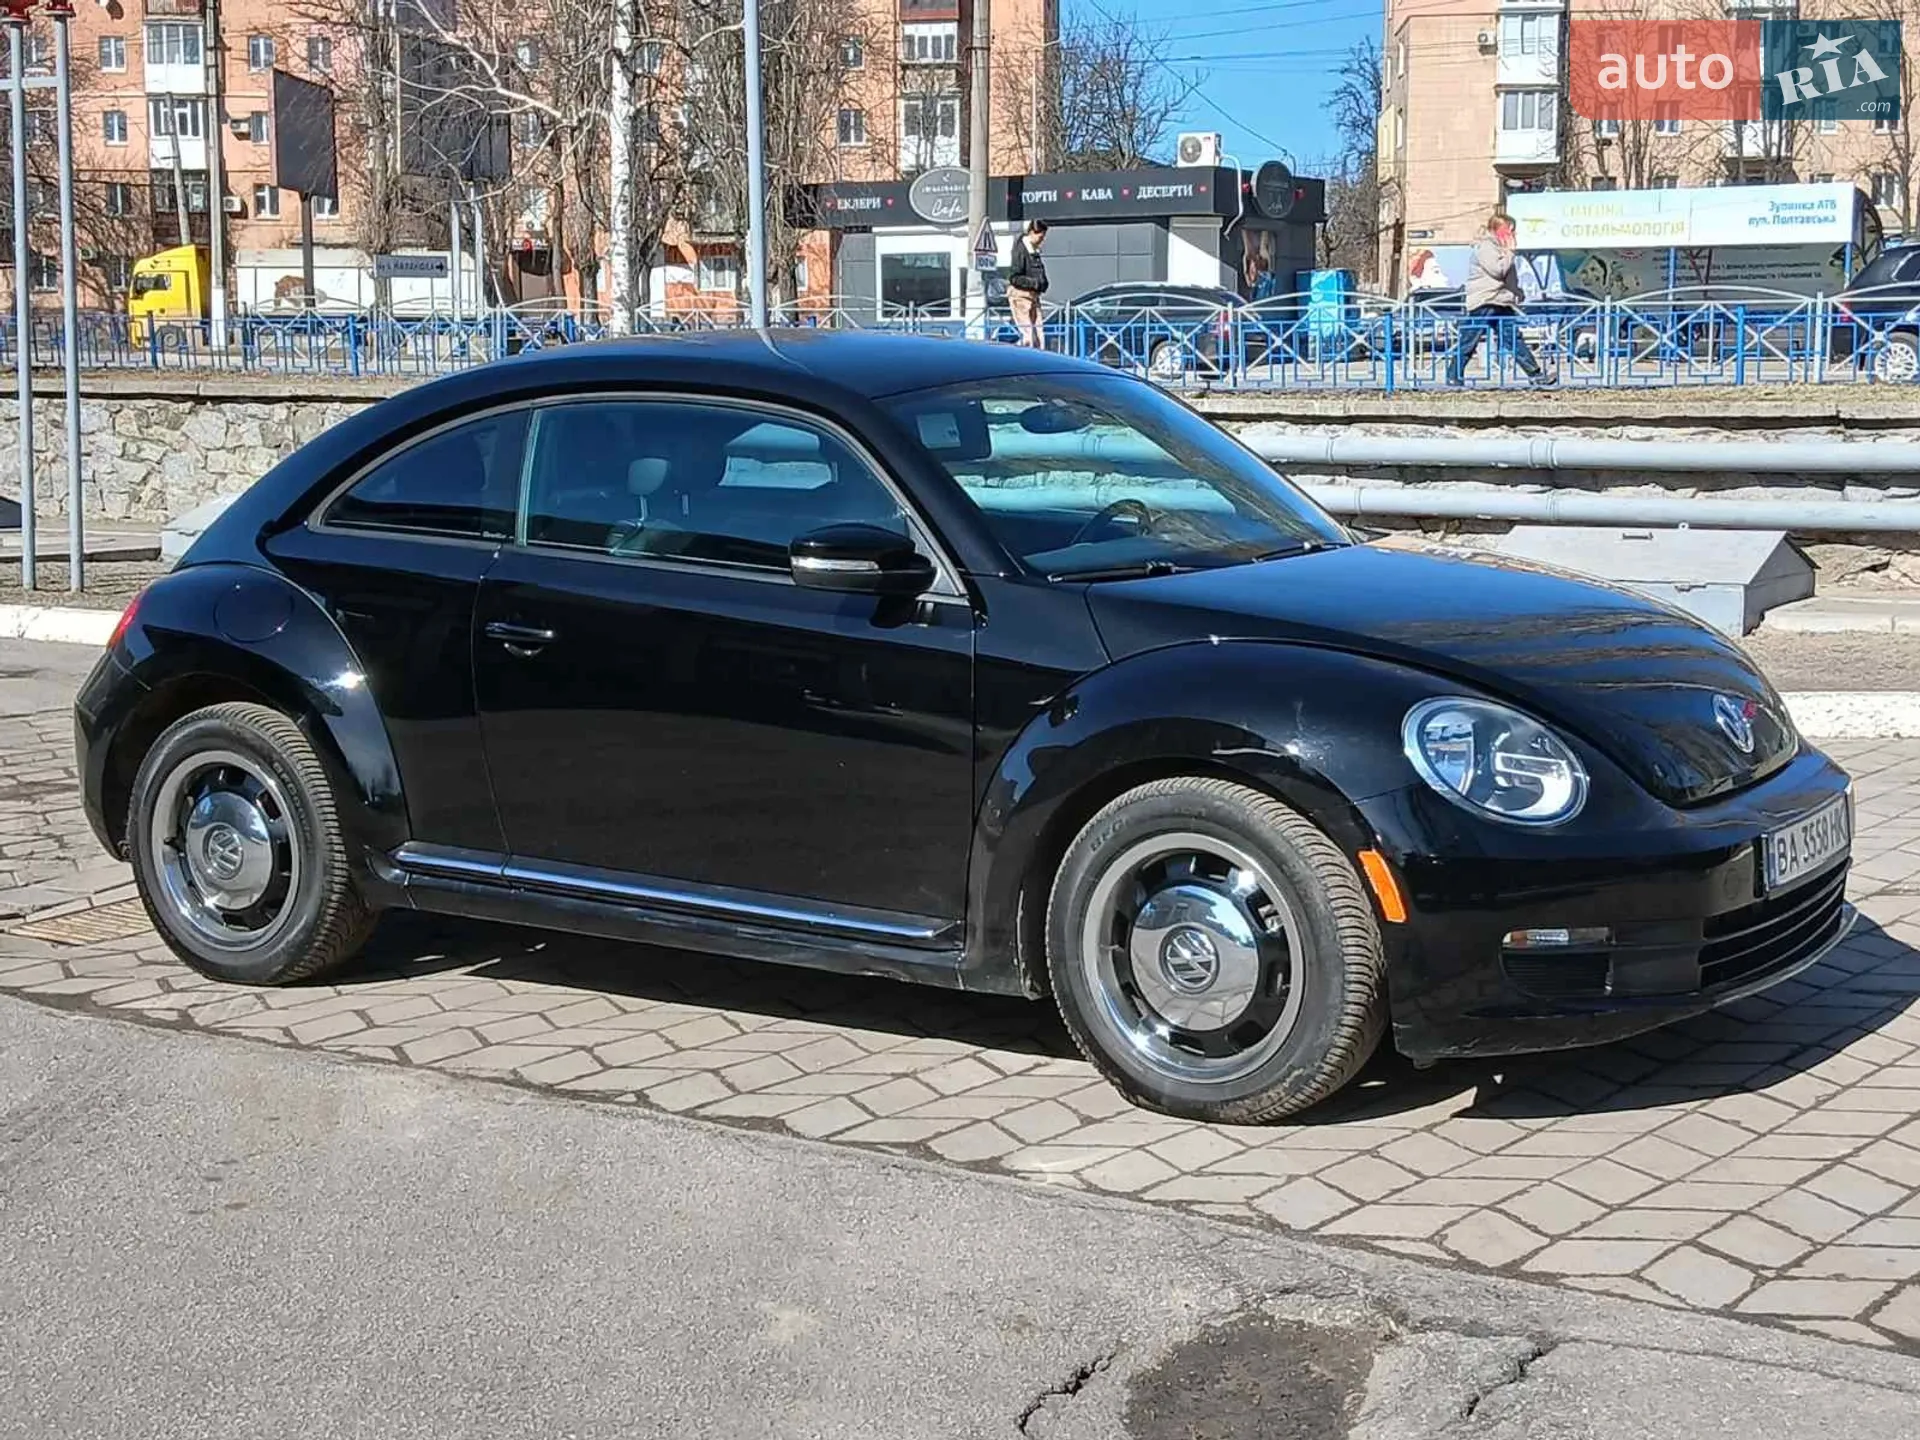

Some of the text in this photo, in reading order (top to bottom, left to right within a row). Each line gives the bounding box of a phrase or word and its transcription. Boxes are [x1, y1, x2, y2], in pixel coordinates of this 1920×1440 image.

[1081, 187, 1113, 201] КАВА
[1136, 184, 1193, 200] ДЕСЕРТИ
[837, 197, 881, 210] ЕКЛЕРИ
[1768, 200, 1815, 213] Зупинка
[1773, 214, 1837, 225] Полтавська
[1561, 220, 1685, 238] ОФТАЛЬМОЛОГІЯ
[1777, 832, 1800, 877] BA
